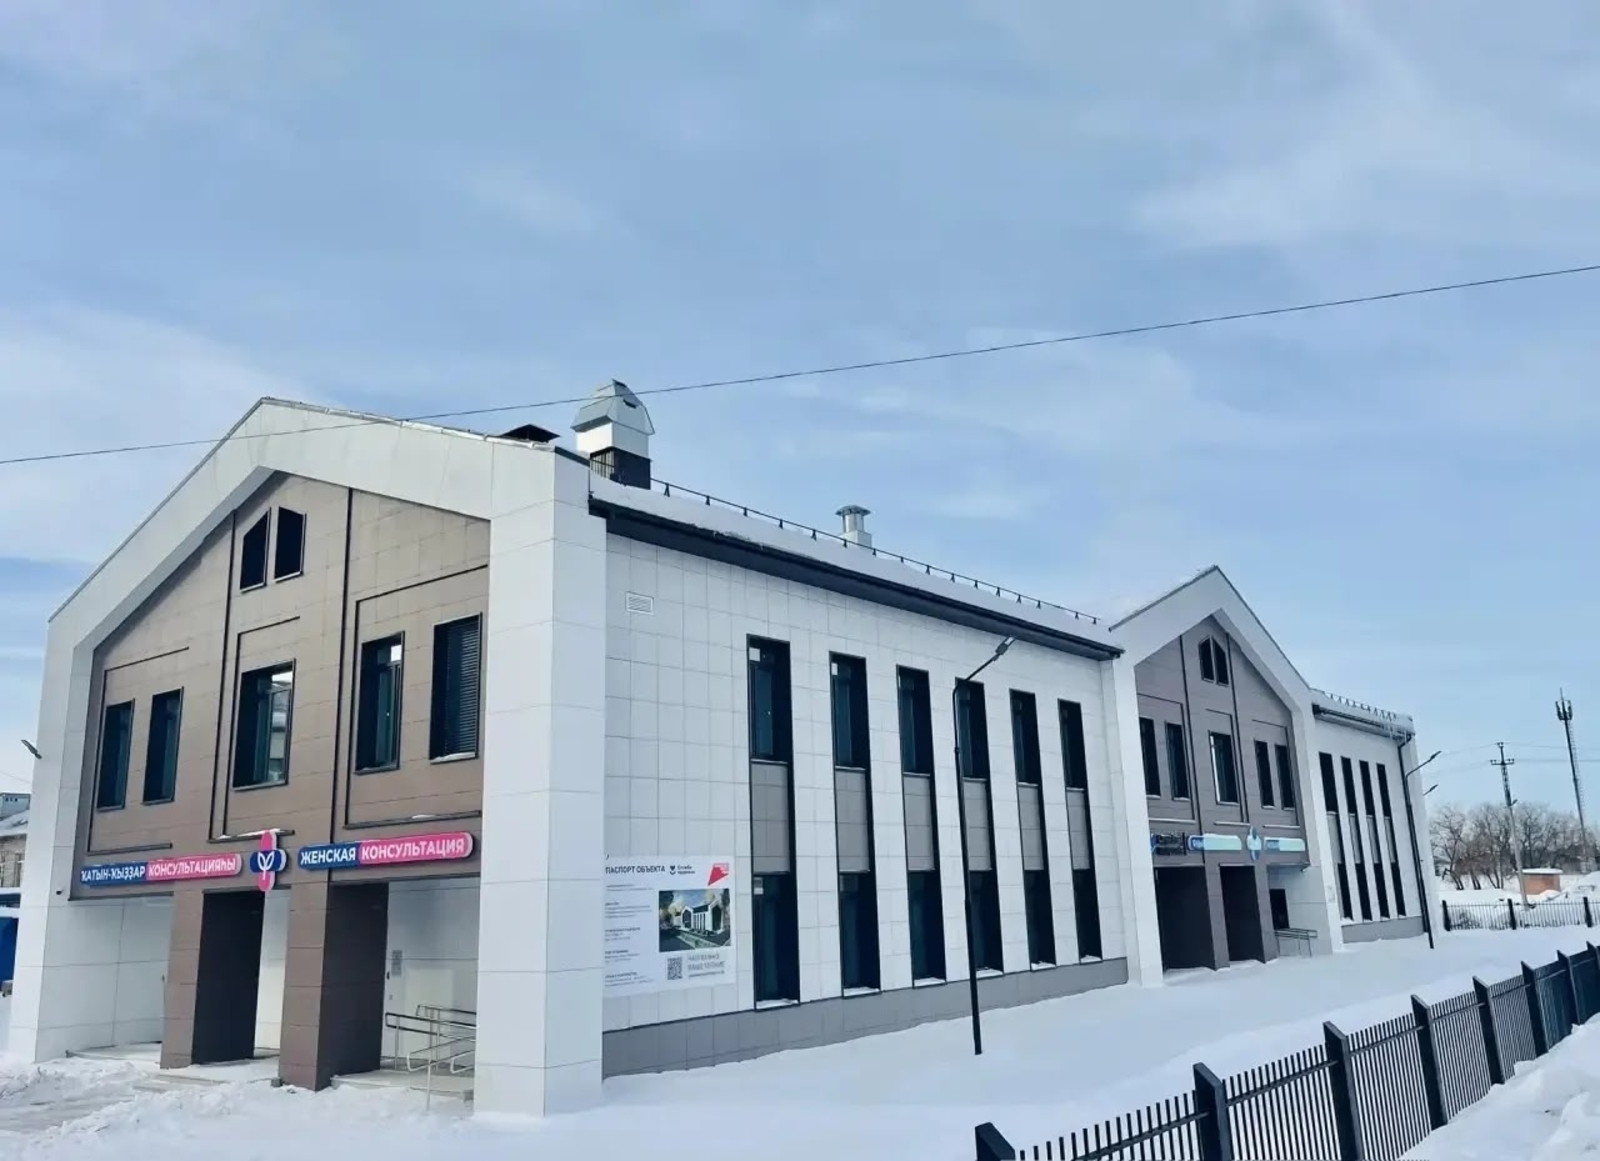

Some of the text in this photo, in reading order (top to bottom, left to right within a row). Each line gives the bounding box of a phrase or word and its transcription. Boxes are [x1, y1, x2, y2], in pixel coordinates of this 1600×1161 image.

[300, 838, 465, 865] ЖЕНСКАЯ КОНСУЛЬТАЦИЯ
[605, 865, 666, 874] ПАСПОРТ ОБЪЕКТА
